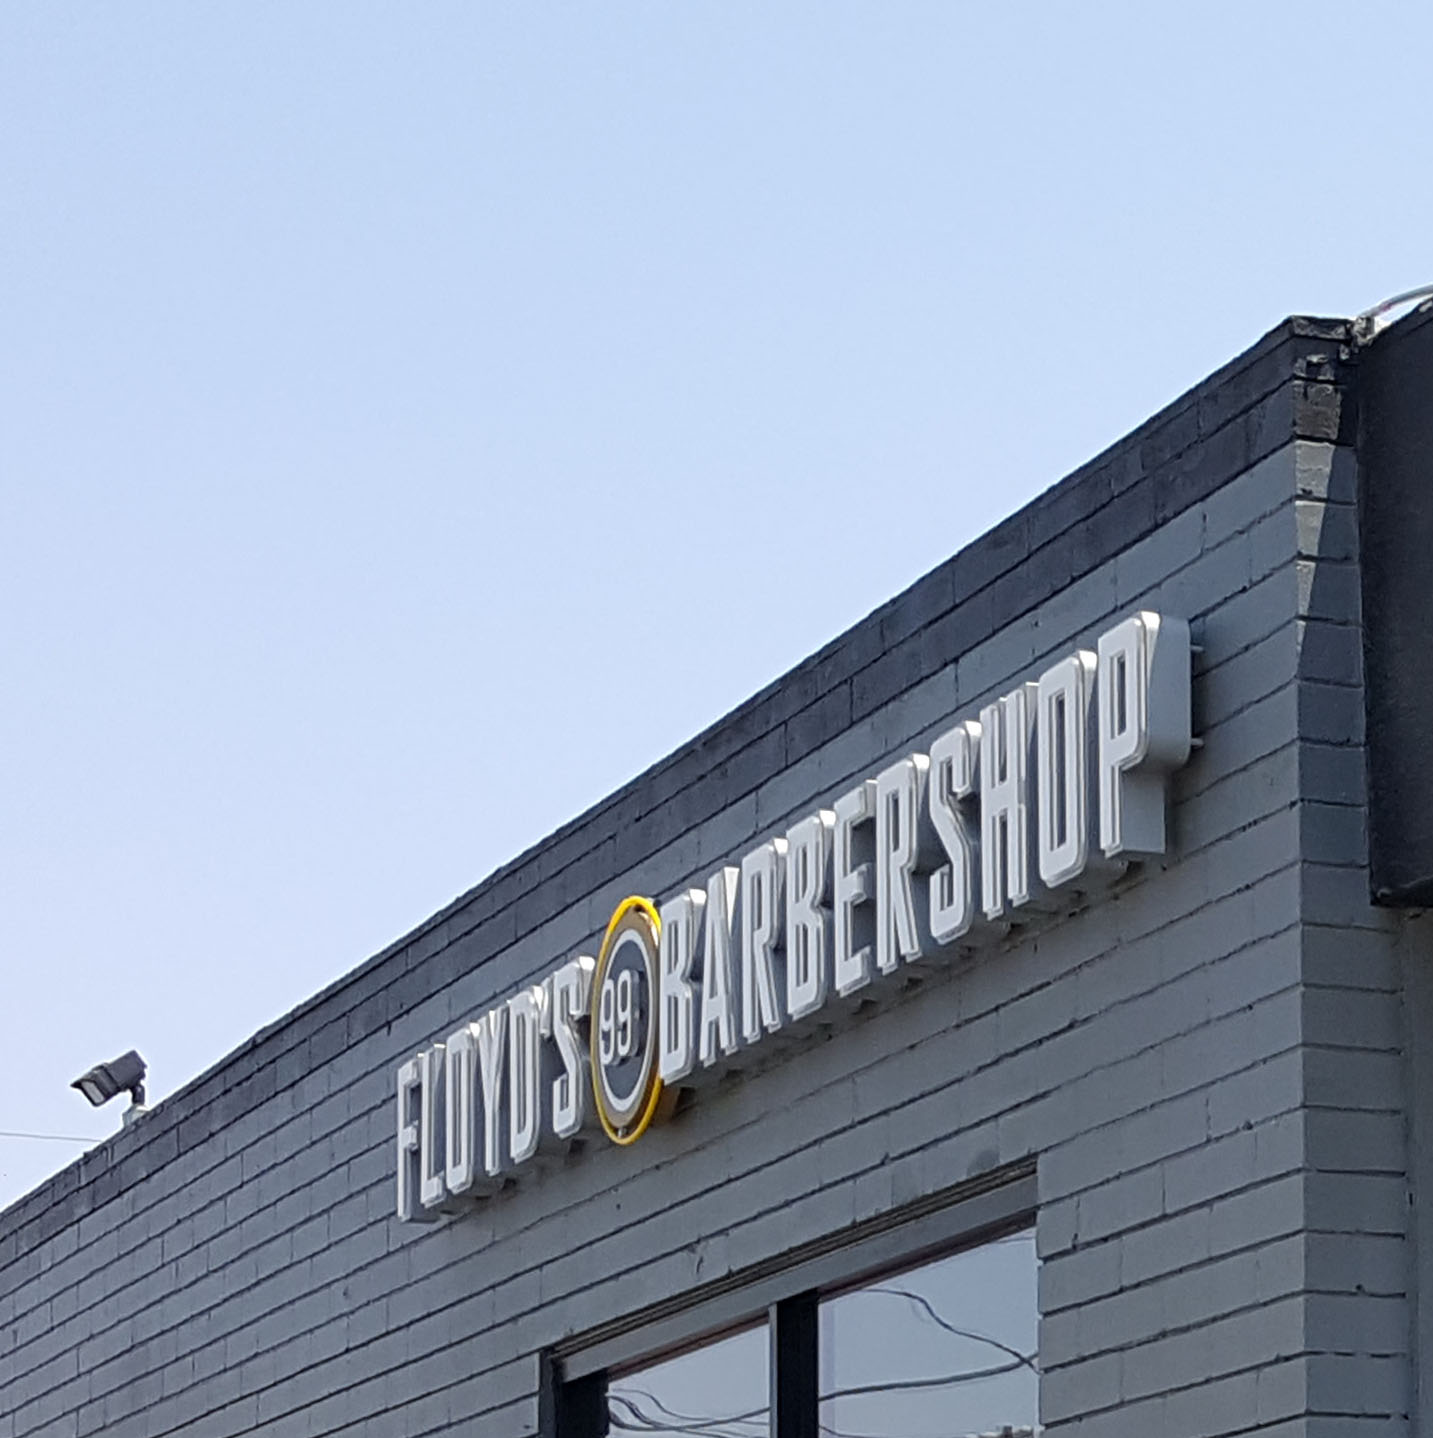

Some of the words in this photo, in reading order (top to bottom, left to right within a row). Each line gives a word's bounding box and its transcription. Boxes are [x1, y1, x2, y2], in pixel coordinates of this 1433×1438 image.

[397, 956, 596, 1222] FLOYD'S
[599, 970, 639, 1065] 99
[659, 611, 1165, 1086] BARBERSHOP
